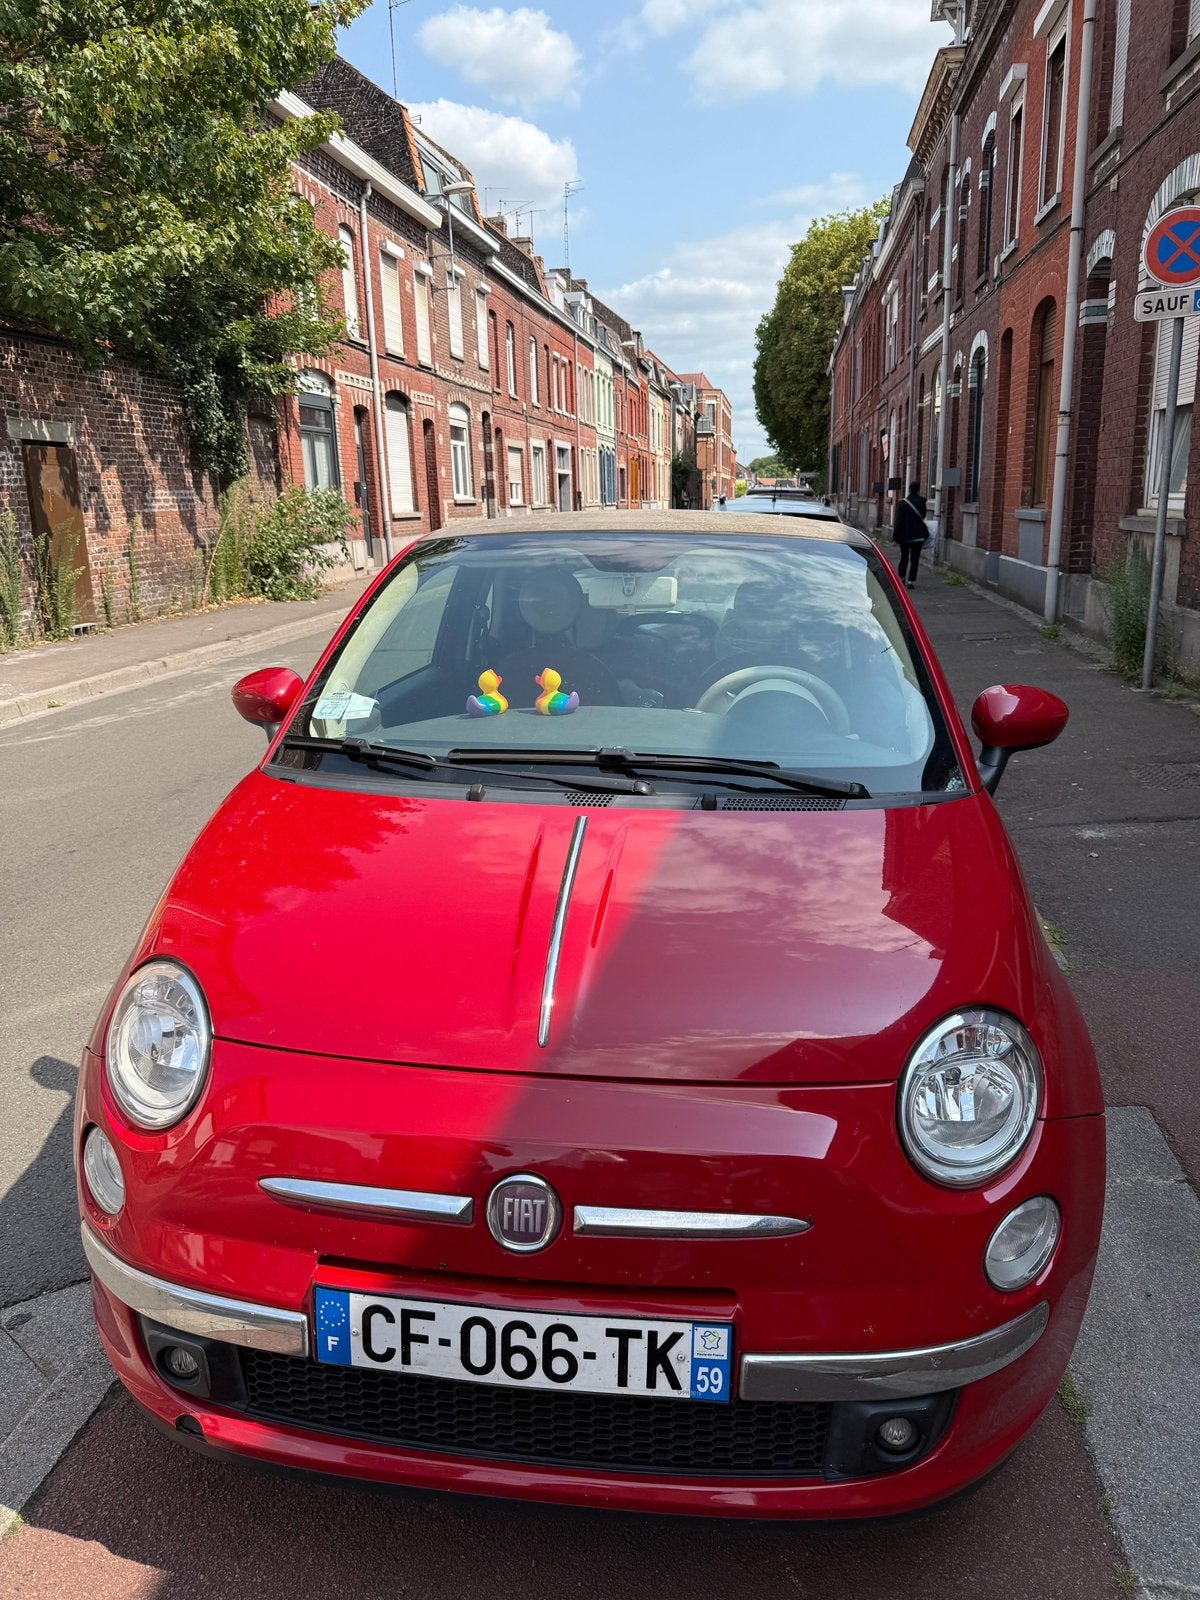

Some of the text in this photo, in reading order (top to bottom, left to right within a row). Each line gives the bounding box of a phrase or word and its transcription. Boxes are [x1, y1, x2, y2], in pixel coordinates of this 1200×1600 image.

[1143, 295, 1189, 314] SAUF
[503, 1197, 545, 1233] FIAT
[327, 1335, 340, 1352] F
[361, 1304, 684, 1391] CF-066-TK
[696, 1366, 723, 1394] 59
